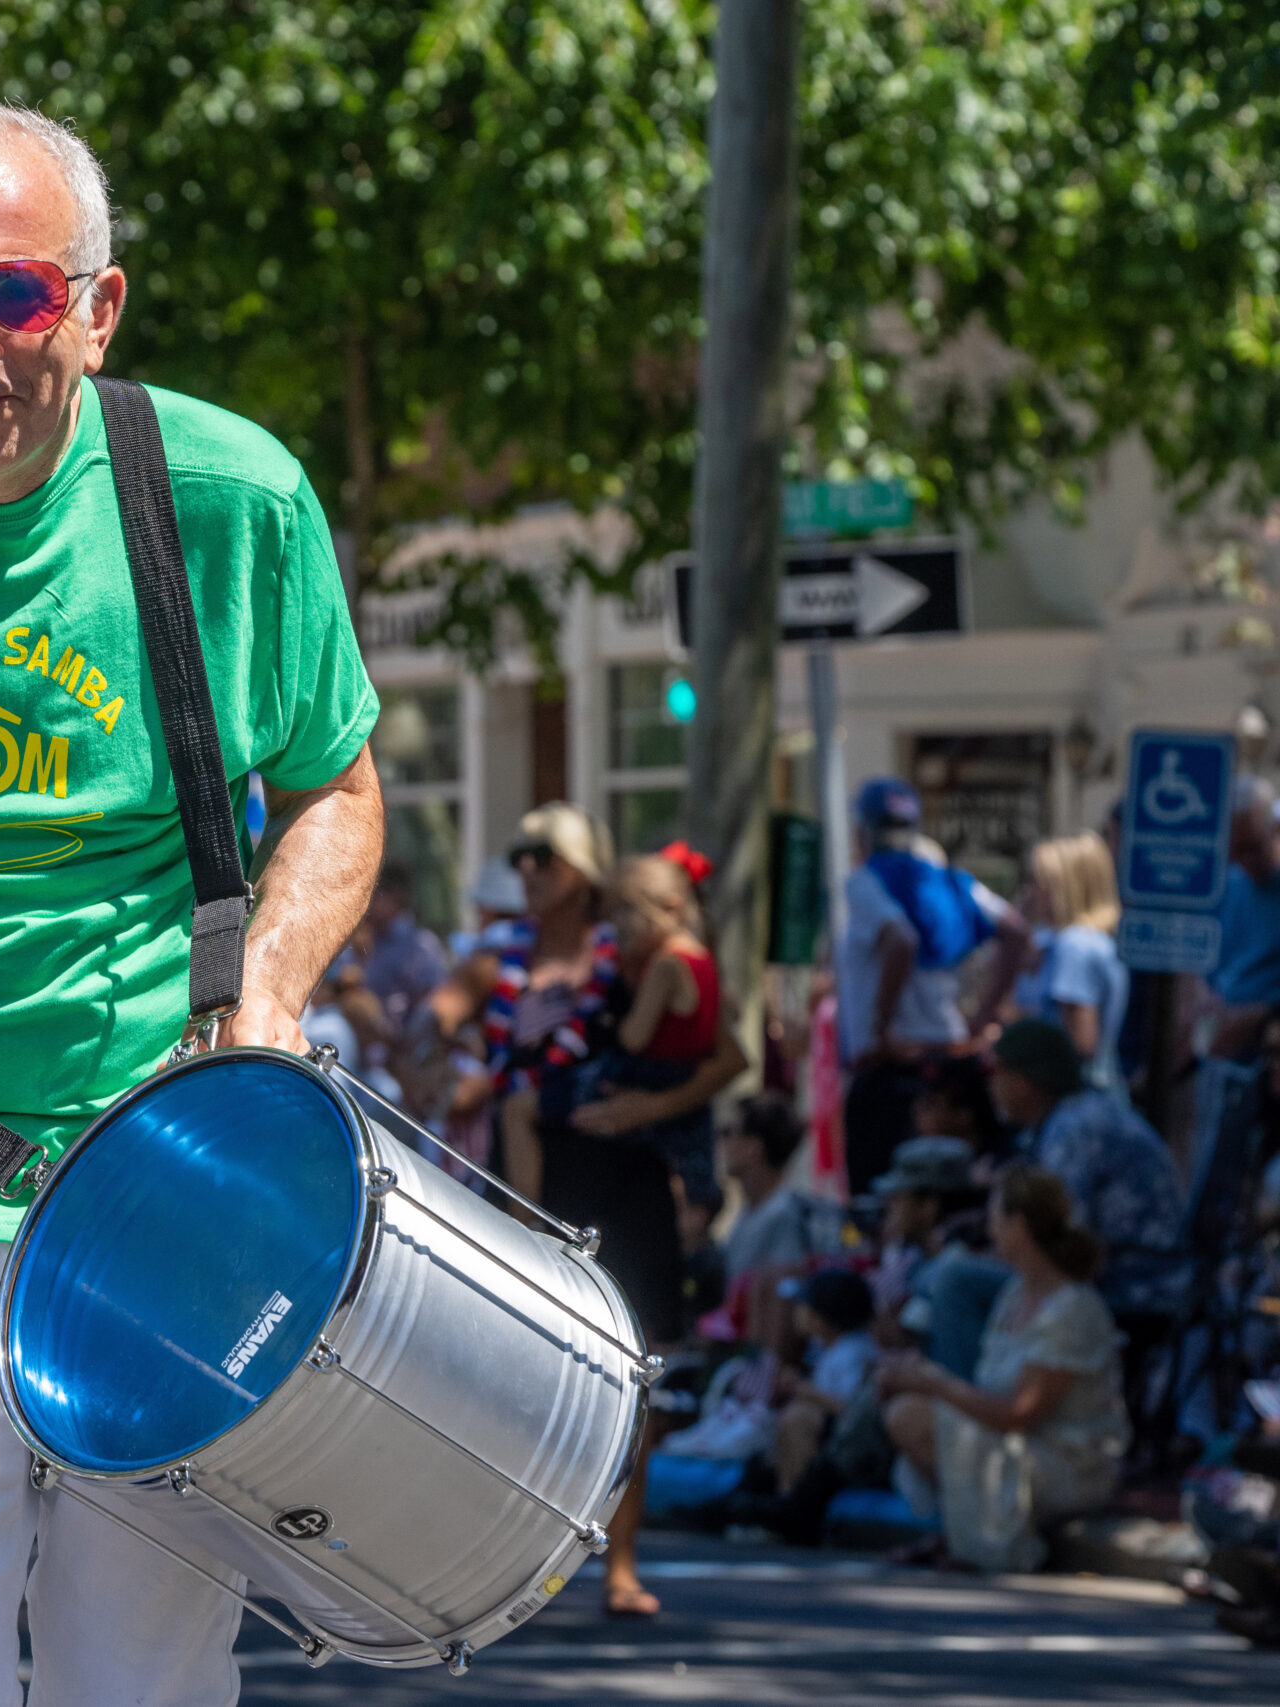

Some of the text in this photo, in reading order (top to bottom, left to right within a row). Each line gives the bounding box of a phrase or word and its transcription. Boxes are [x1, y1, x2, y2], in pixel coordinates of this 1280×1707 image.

[4, 626, 125, 736] SAMBA
[221, 1315, 262, 1369] HYDRAULIC
[226, 1294, 293, 1380] EVANS
[277, 1513, 325, 1537] LP
